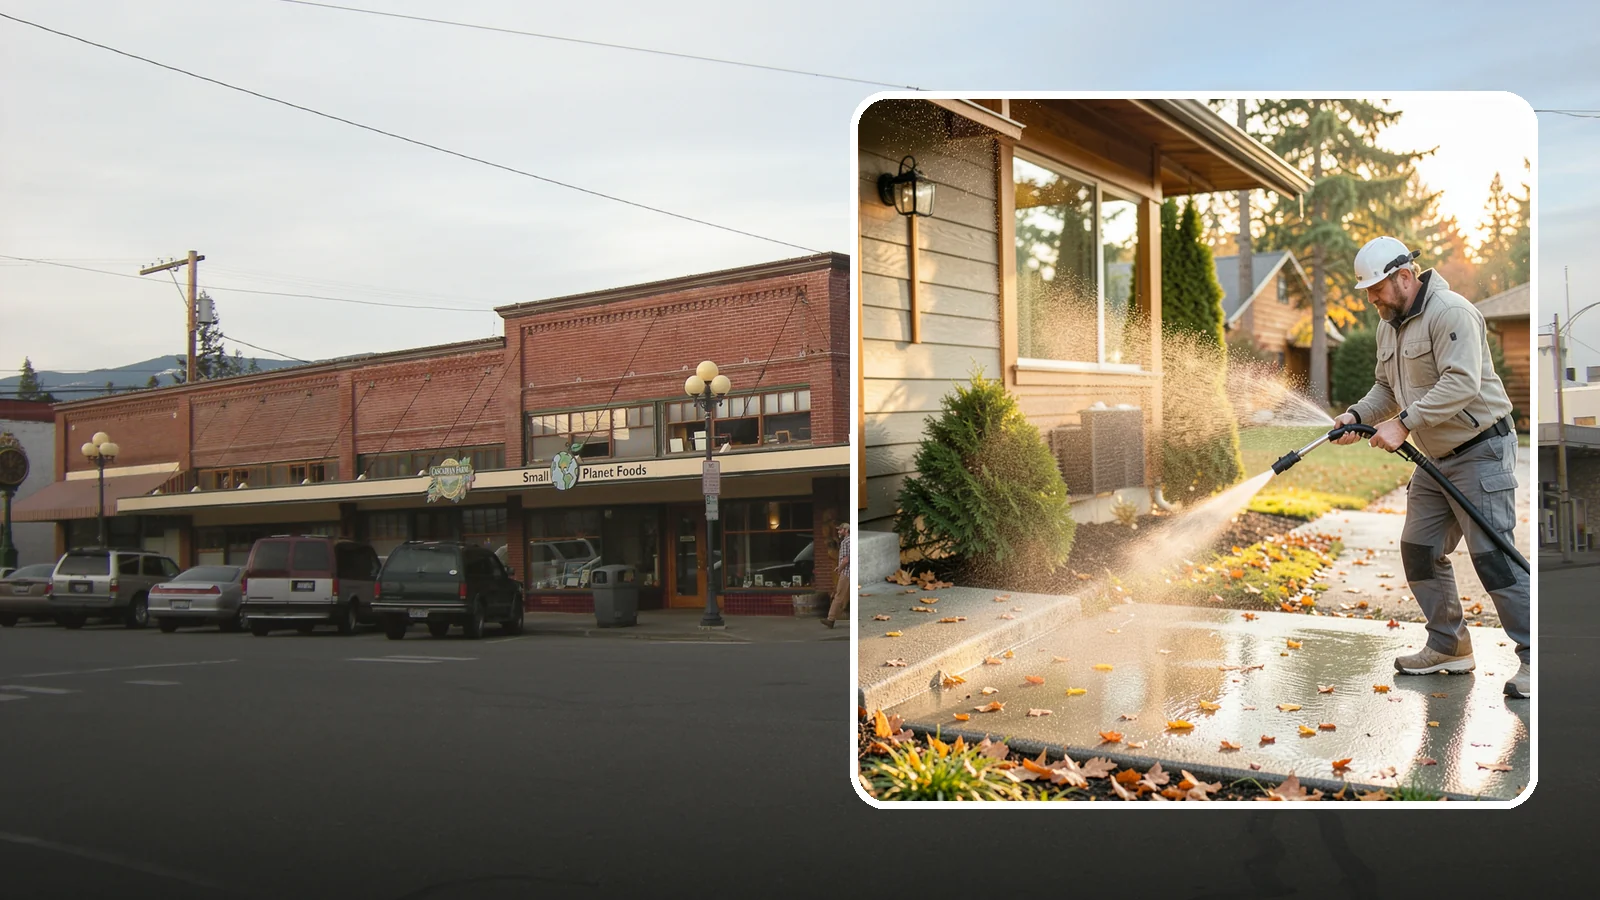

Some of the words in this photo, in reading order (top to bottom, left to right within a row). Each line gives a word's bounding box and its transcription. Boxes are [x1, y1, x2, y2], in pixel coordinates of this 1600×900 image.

[523, 471, 549, 483] Small
[583, 467, 614, 479] Planet
[616, 465, 647, 477] Foods
